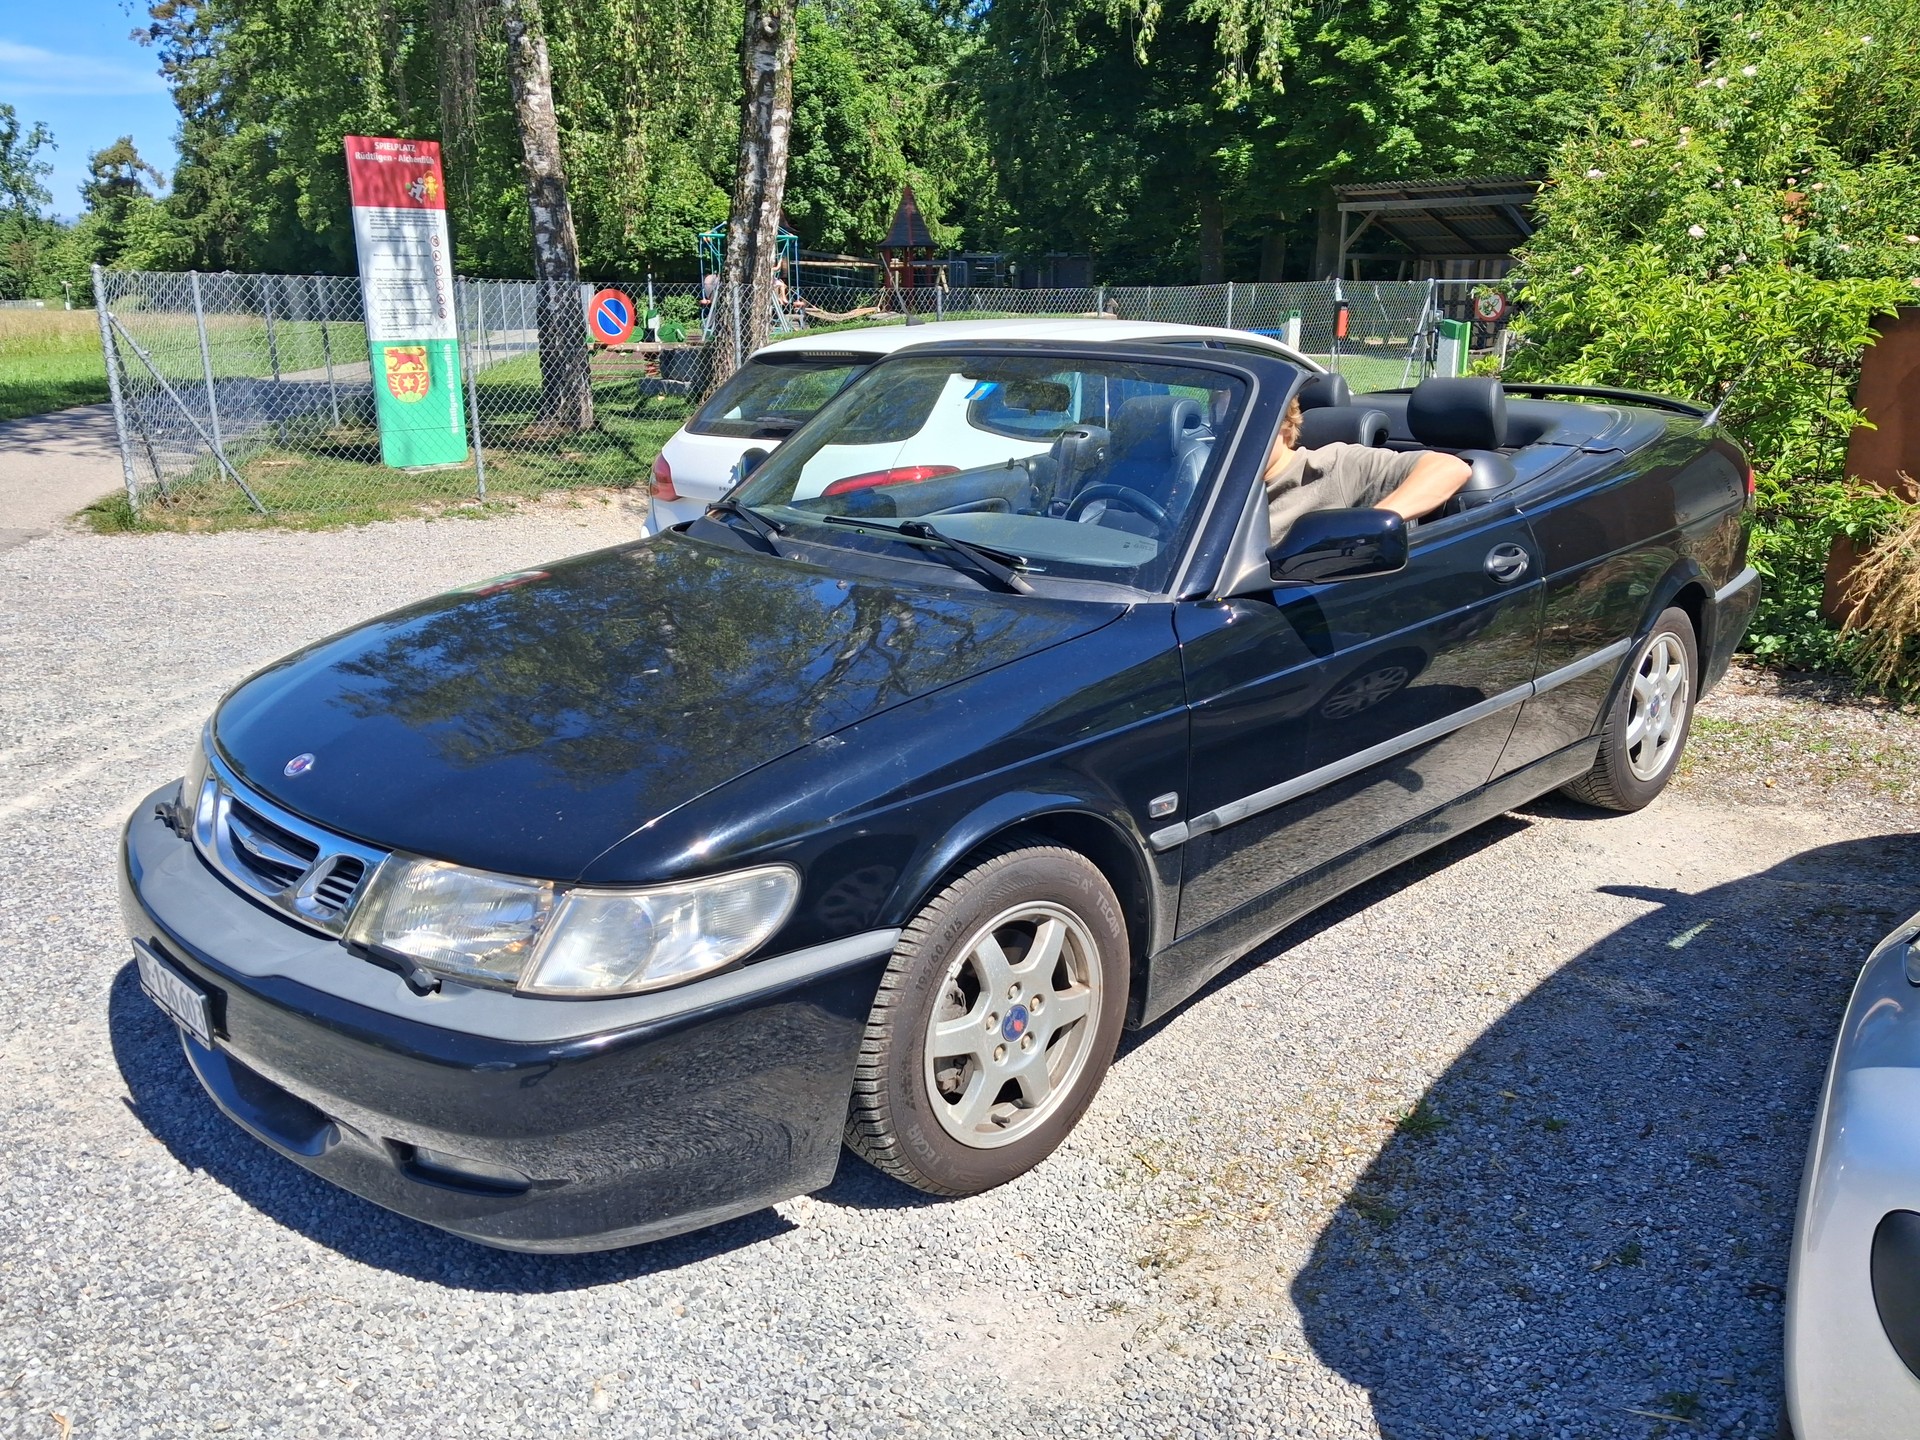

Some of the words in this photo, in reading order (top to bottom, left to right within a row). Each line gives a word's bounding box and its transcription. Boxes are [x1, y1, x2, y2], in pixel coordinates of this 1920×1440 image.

[374, 141, 416, 152] SPIELPLATZ
[1096, 890, 1121, 939] TECAR
[915, 944, 945, 991] 195/60
